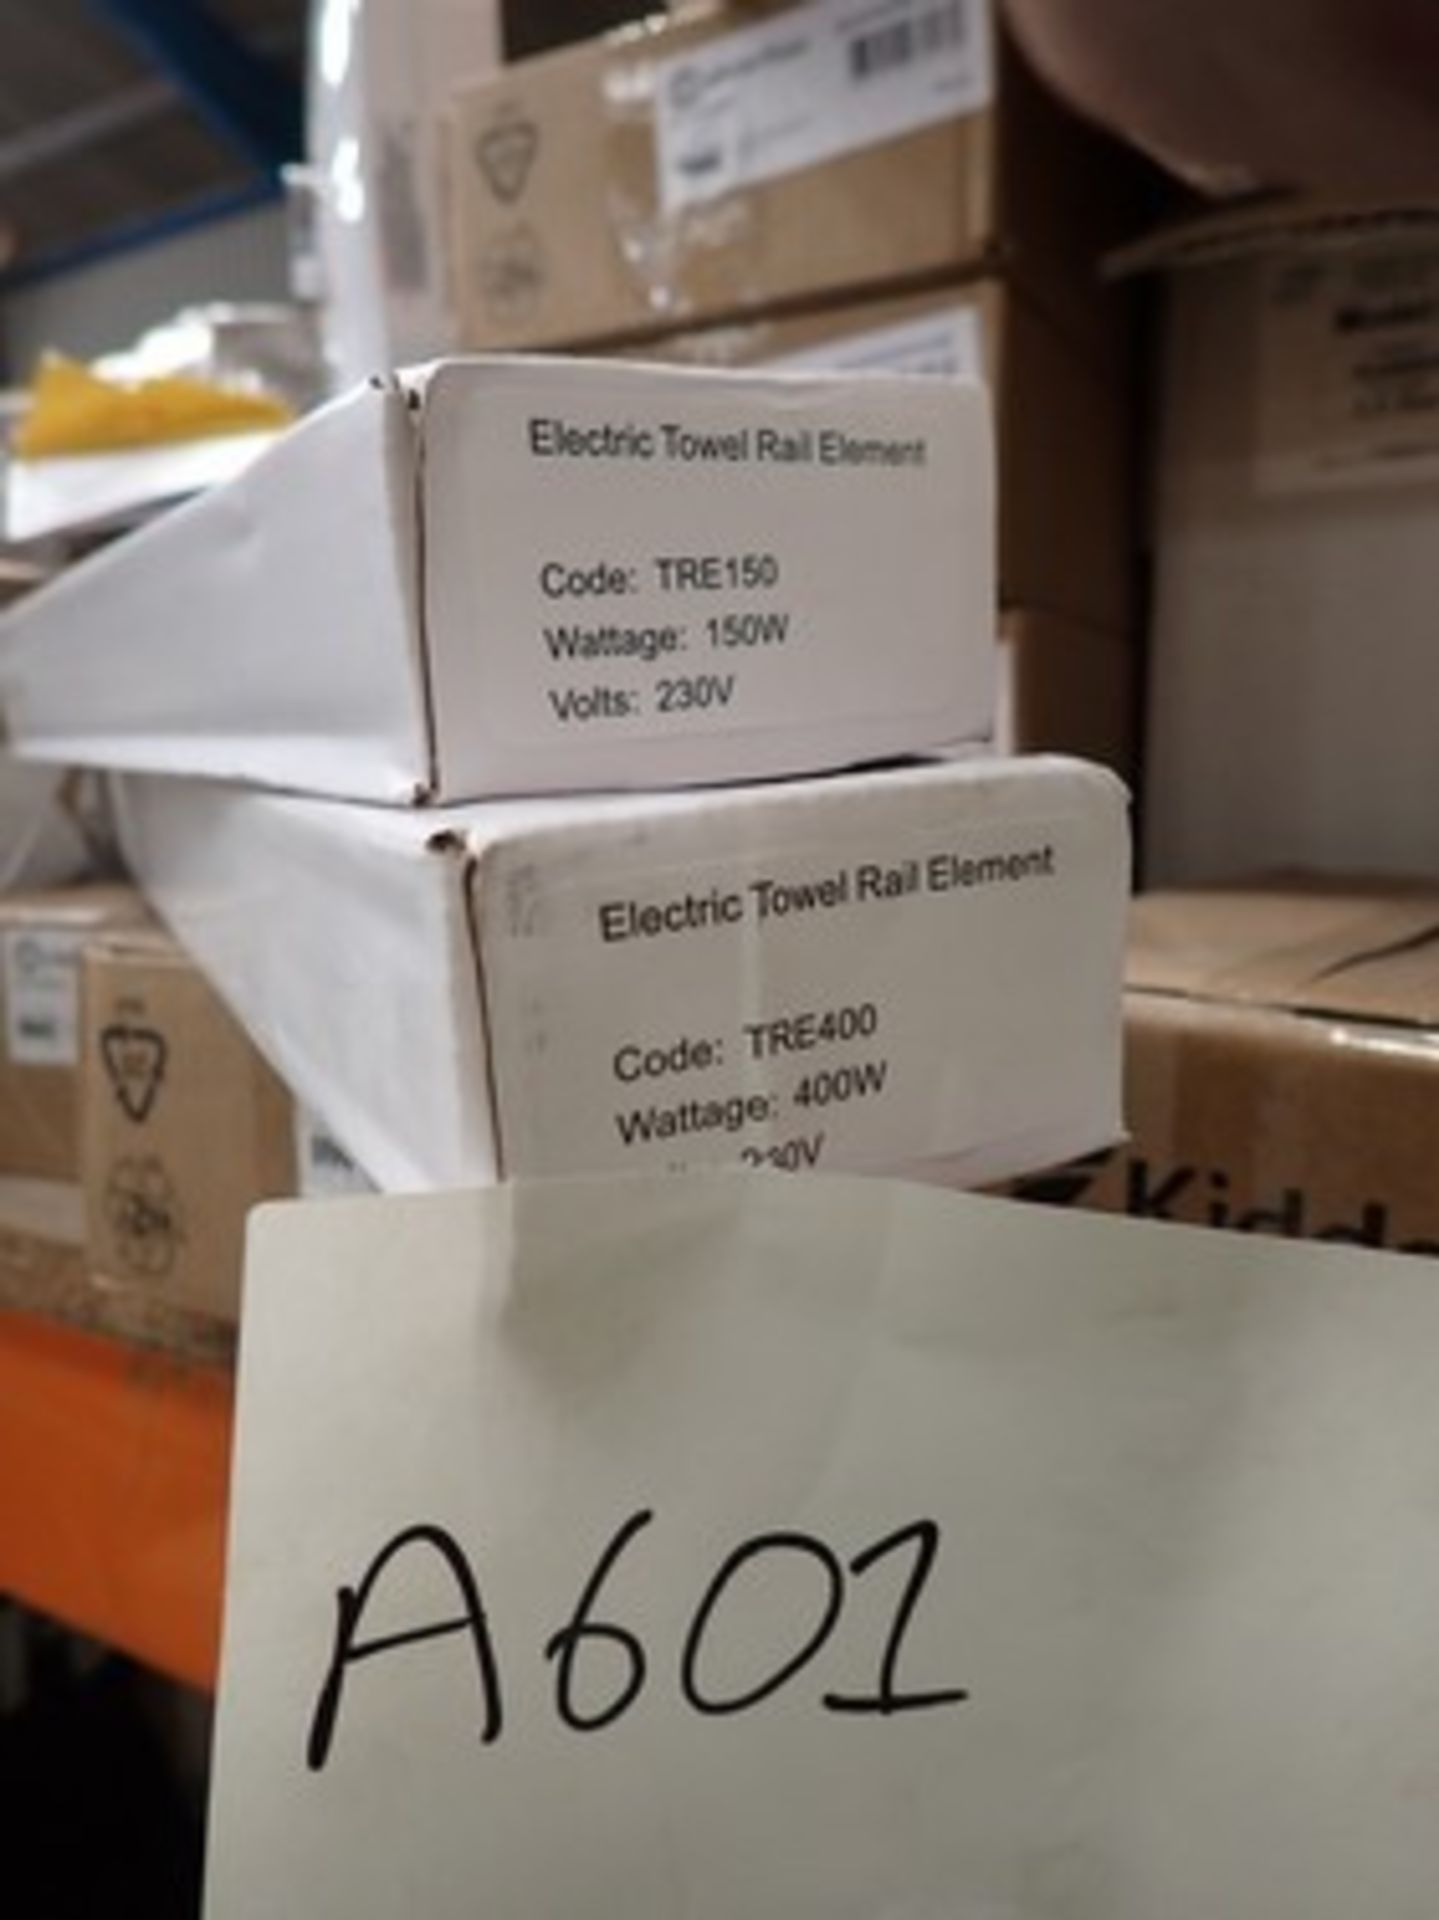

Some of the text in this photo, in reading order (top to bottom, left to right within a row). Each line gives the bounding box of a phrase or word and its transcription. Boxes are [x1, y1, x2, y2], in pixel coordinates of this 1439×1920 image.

[529, 418, 927, 466] Electric Towel Rail Element
[540, 555, 778, 598] Code: TRE150
[543, 613, 789, 660] Wattage: 150W
[548, 676, 734, 721] Volts: 230V
[600, 845, 1054, 943] Electric Towel Rail Element
[613, 1003, 878, 1084] Code: TRE400
[616, 1060, 888, 1146] Wattage: 400W
[306, 1508, 969, 1772] A601
